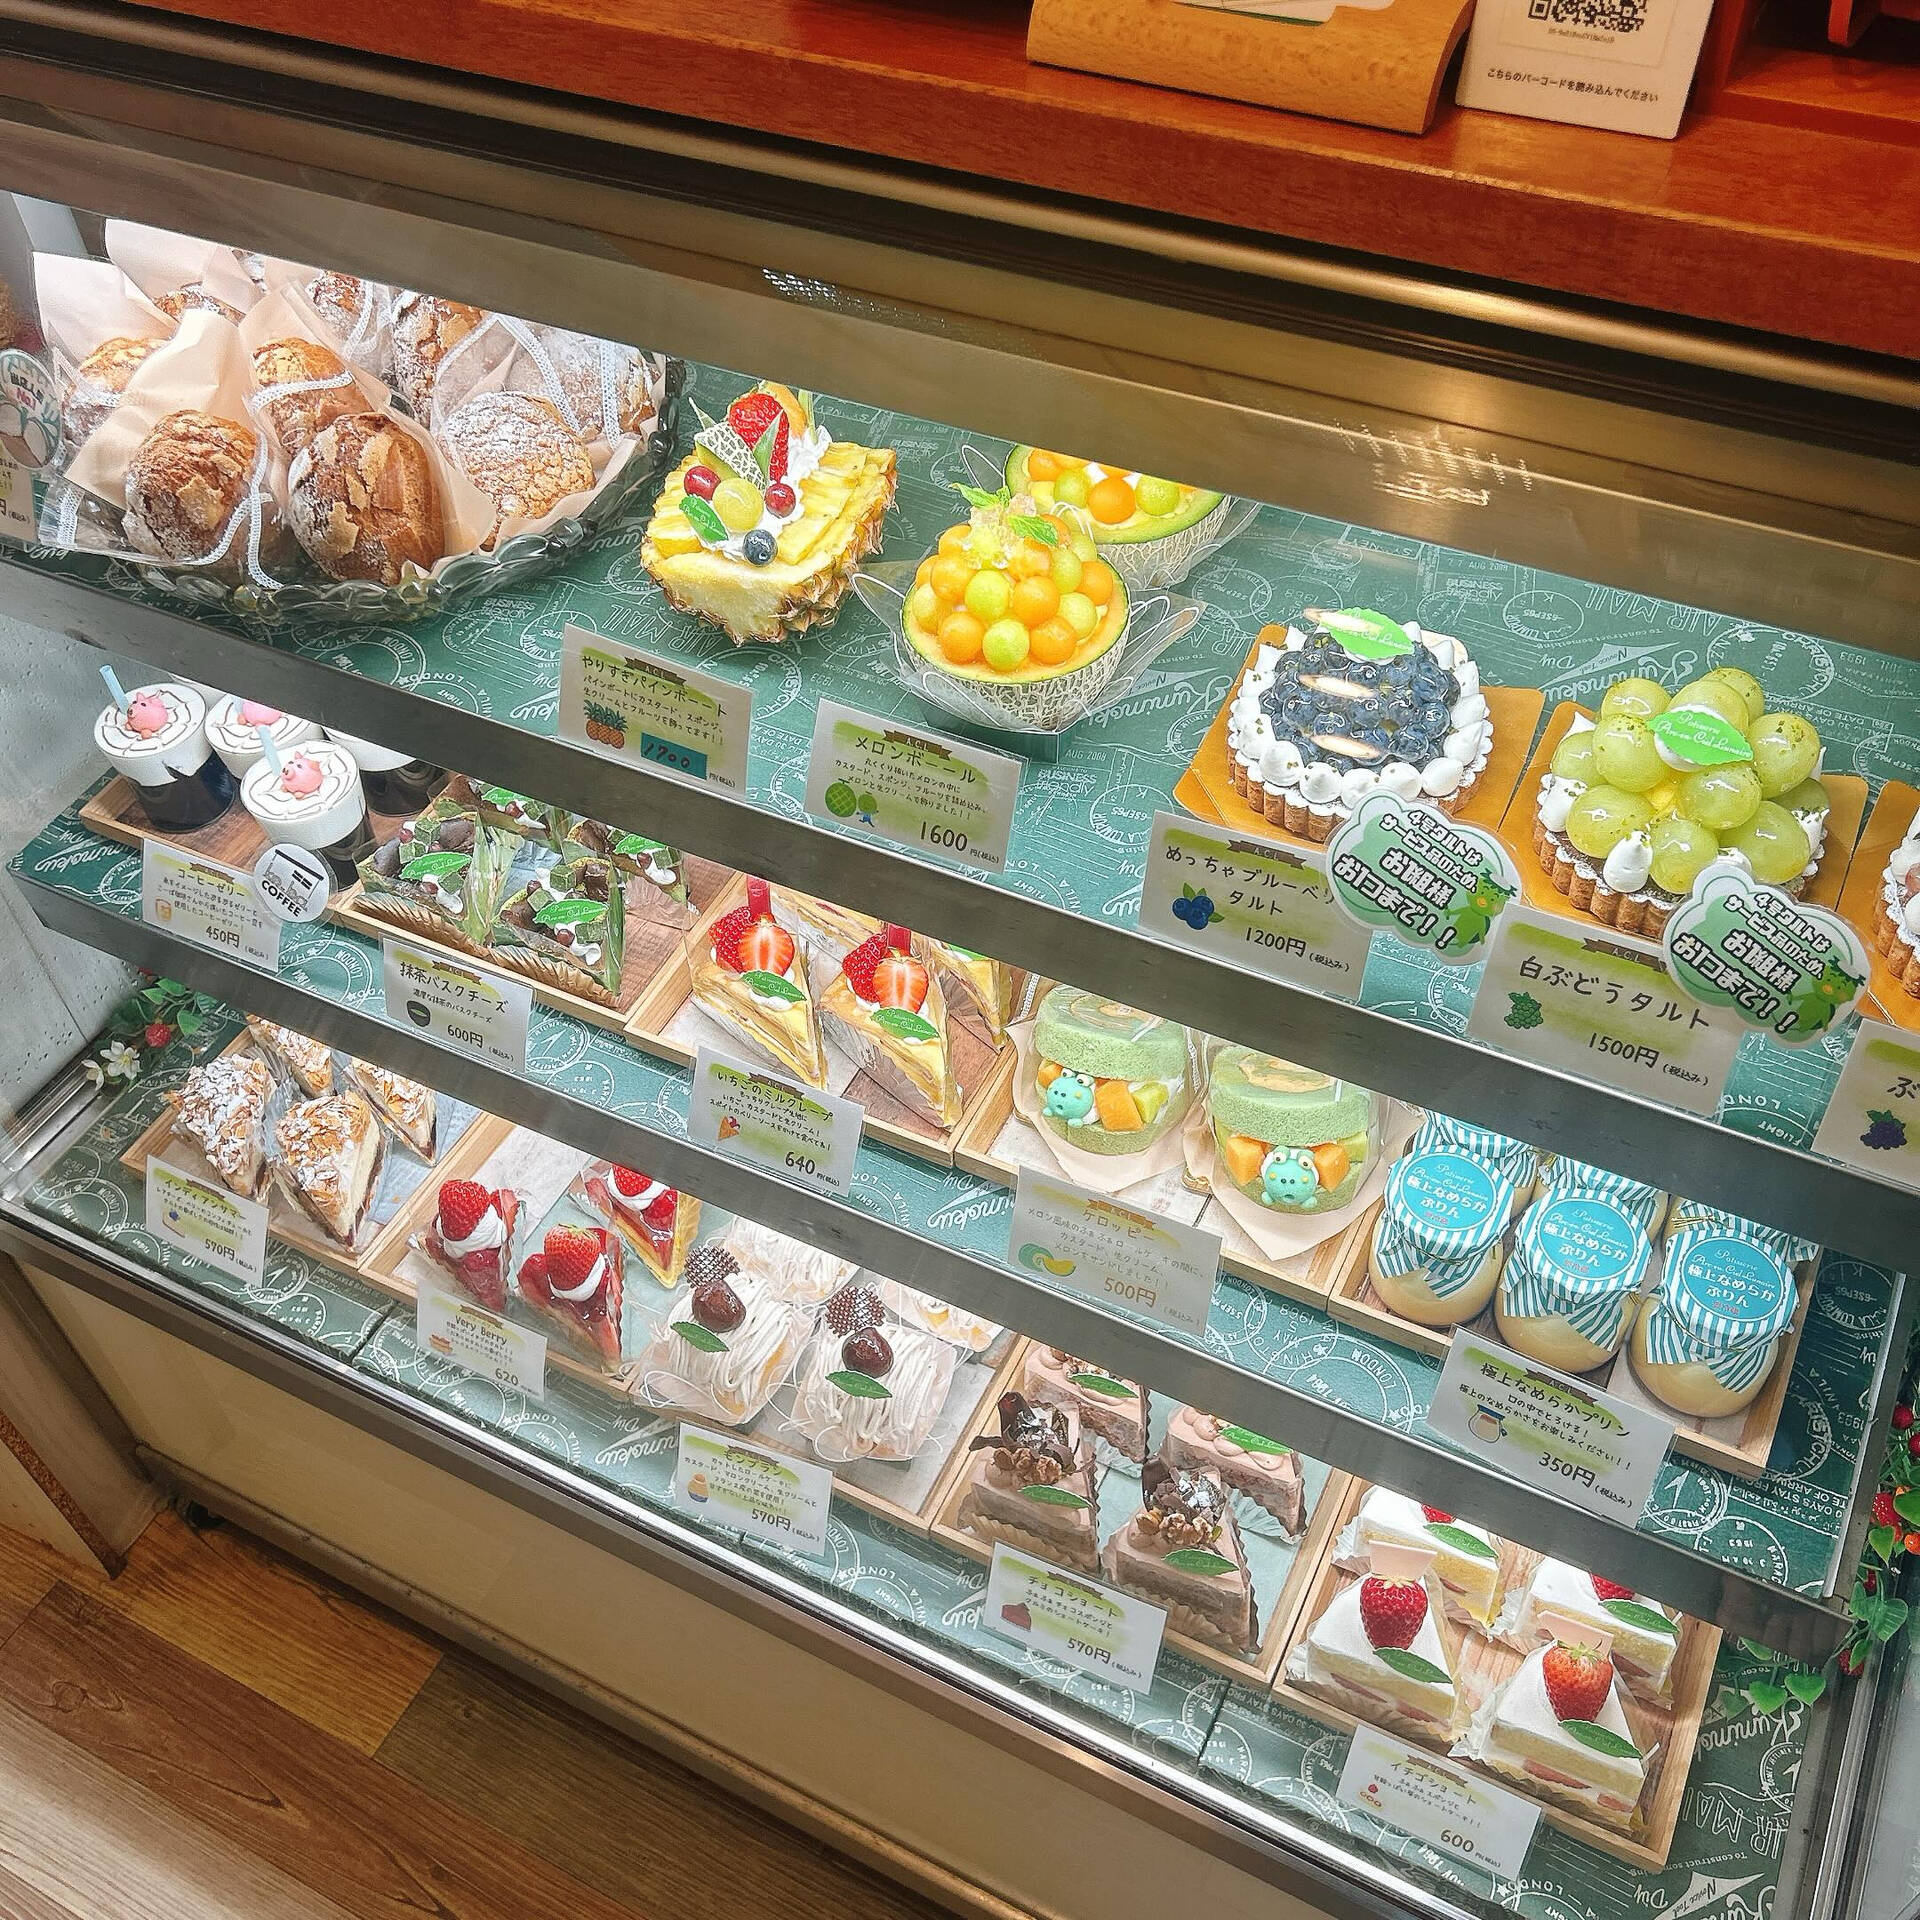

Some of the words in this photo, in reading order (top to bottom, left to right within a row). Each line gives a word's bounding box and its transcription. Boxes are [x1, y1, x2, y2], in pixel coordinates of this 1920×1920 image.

[1487, 68, 1659, 102] こちらのバーコードを読み込んでください
[643, 742, 690, 769] 1700
[920, 821, 968, 852] 1600
[1379, 813, 1479, 893] サービス品のため、
[1408, 809, 1484, 867] 4号タルトは
[178, 867, 246, 899] コーヒーゼリー
[261, 879, 302, 918] COFFEE
[1229, 889, 1284, 915] タルト
[205, 925, 241, 949] 450円
[1723, 894, 1824, 980] サービス品のため、
[1754, 892, 1832, 954] 4号タルトは
[1246, 926, 1308, 958] 1200円
[399, 960, 510, 1014] 抹茶バスクチーズ
[1519, 955, 1710, 1030] 白ぶどうタルト
[448, 1024, 484, 1049] 600円
[1588, 1032, 1660, 1069] 1500円
[717, 1071, 835, 1122] いちごのミルクレープ
[785, 1151, 816, 1176] 640
[165, 1179, 247, 1220] インディアンサマー
[1407, 1175, 1488, 1213] 極上なめらか
[1082, 1208, 1155, 1241] ケロッピー
[1544, 1222, 1630, 1261] 極上なめらか
[205, 1238, 235, 1261] 570円
[1104, 1276, 1158, 1308] 500円
[1688, 1263, 1776, 1302] 極上なめらか
[455, 1315, 477, 1332] Very
[481, 1327, 508, 1346] Berry
[495, 1367, 519, 1387] 620
[1480, 1361, 1630, 1438] 極上なめらかプリン
[1507, 1393, 1590, 1439] 口の中でとろける！
[723, 1449, 783, 1476] モンブラン
[1537, 1451, 1597, 1488] 350円
[751, 1508, 791, 1532] 570円
[1028, 1575, 1118, 1618] チョコショート
[1067, 1637, 1112, 1665] 570円
[1391, 1761, 1477, 1806] イチゴショート
[1440, 1829, 1475, 1854] 600
[1633, 1883, 1669, 1909] Diy
